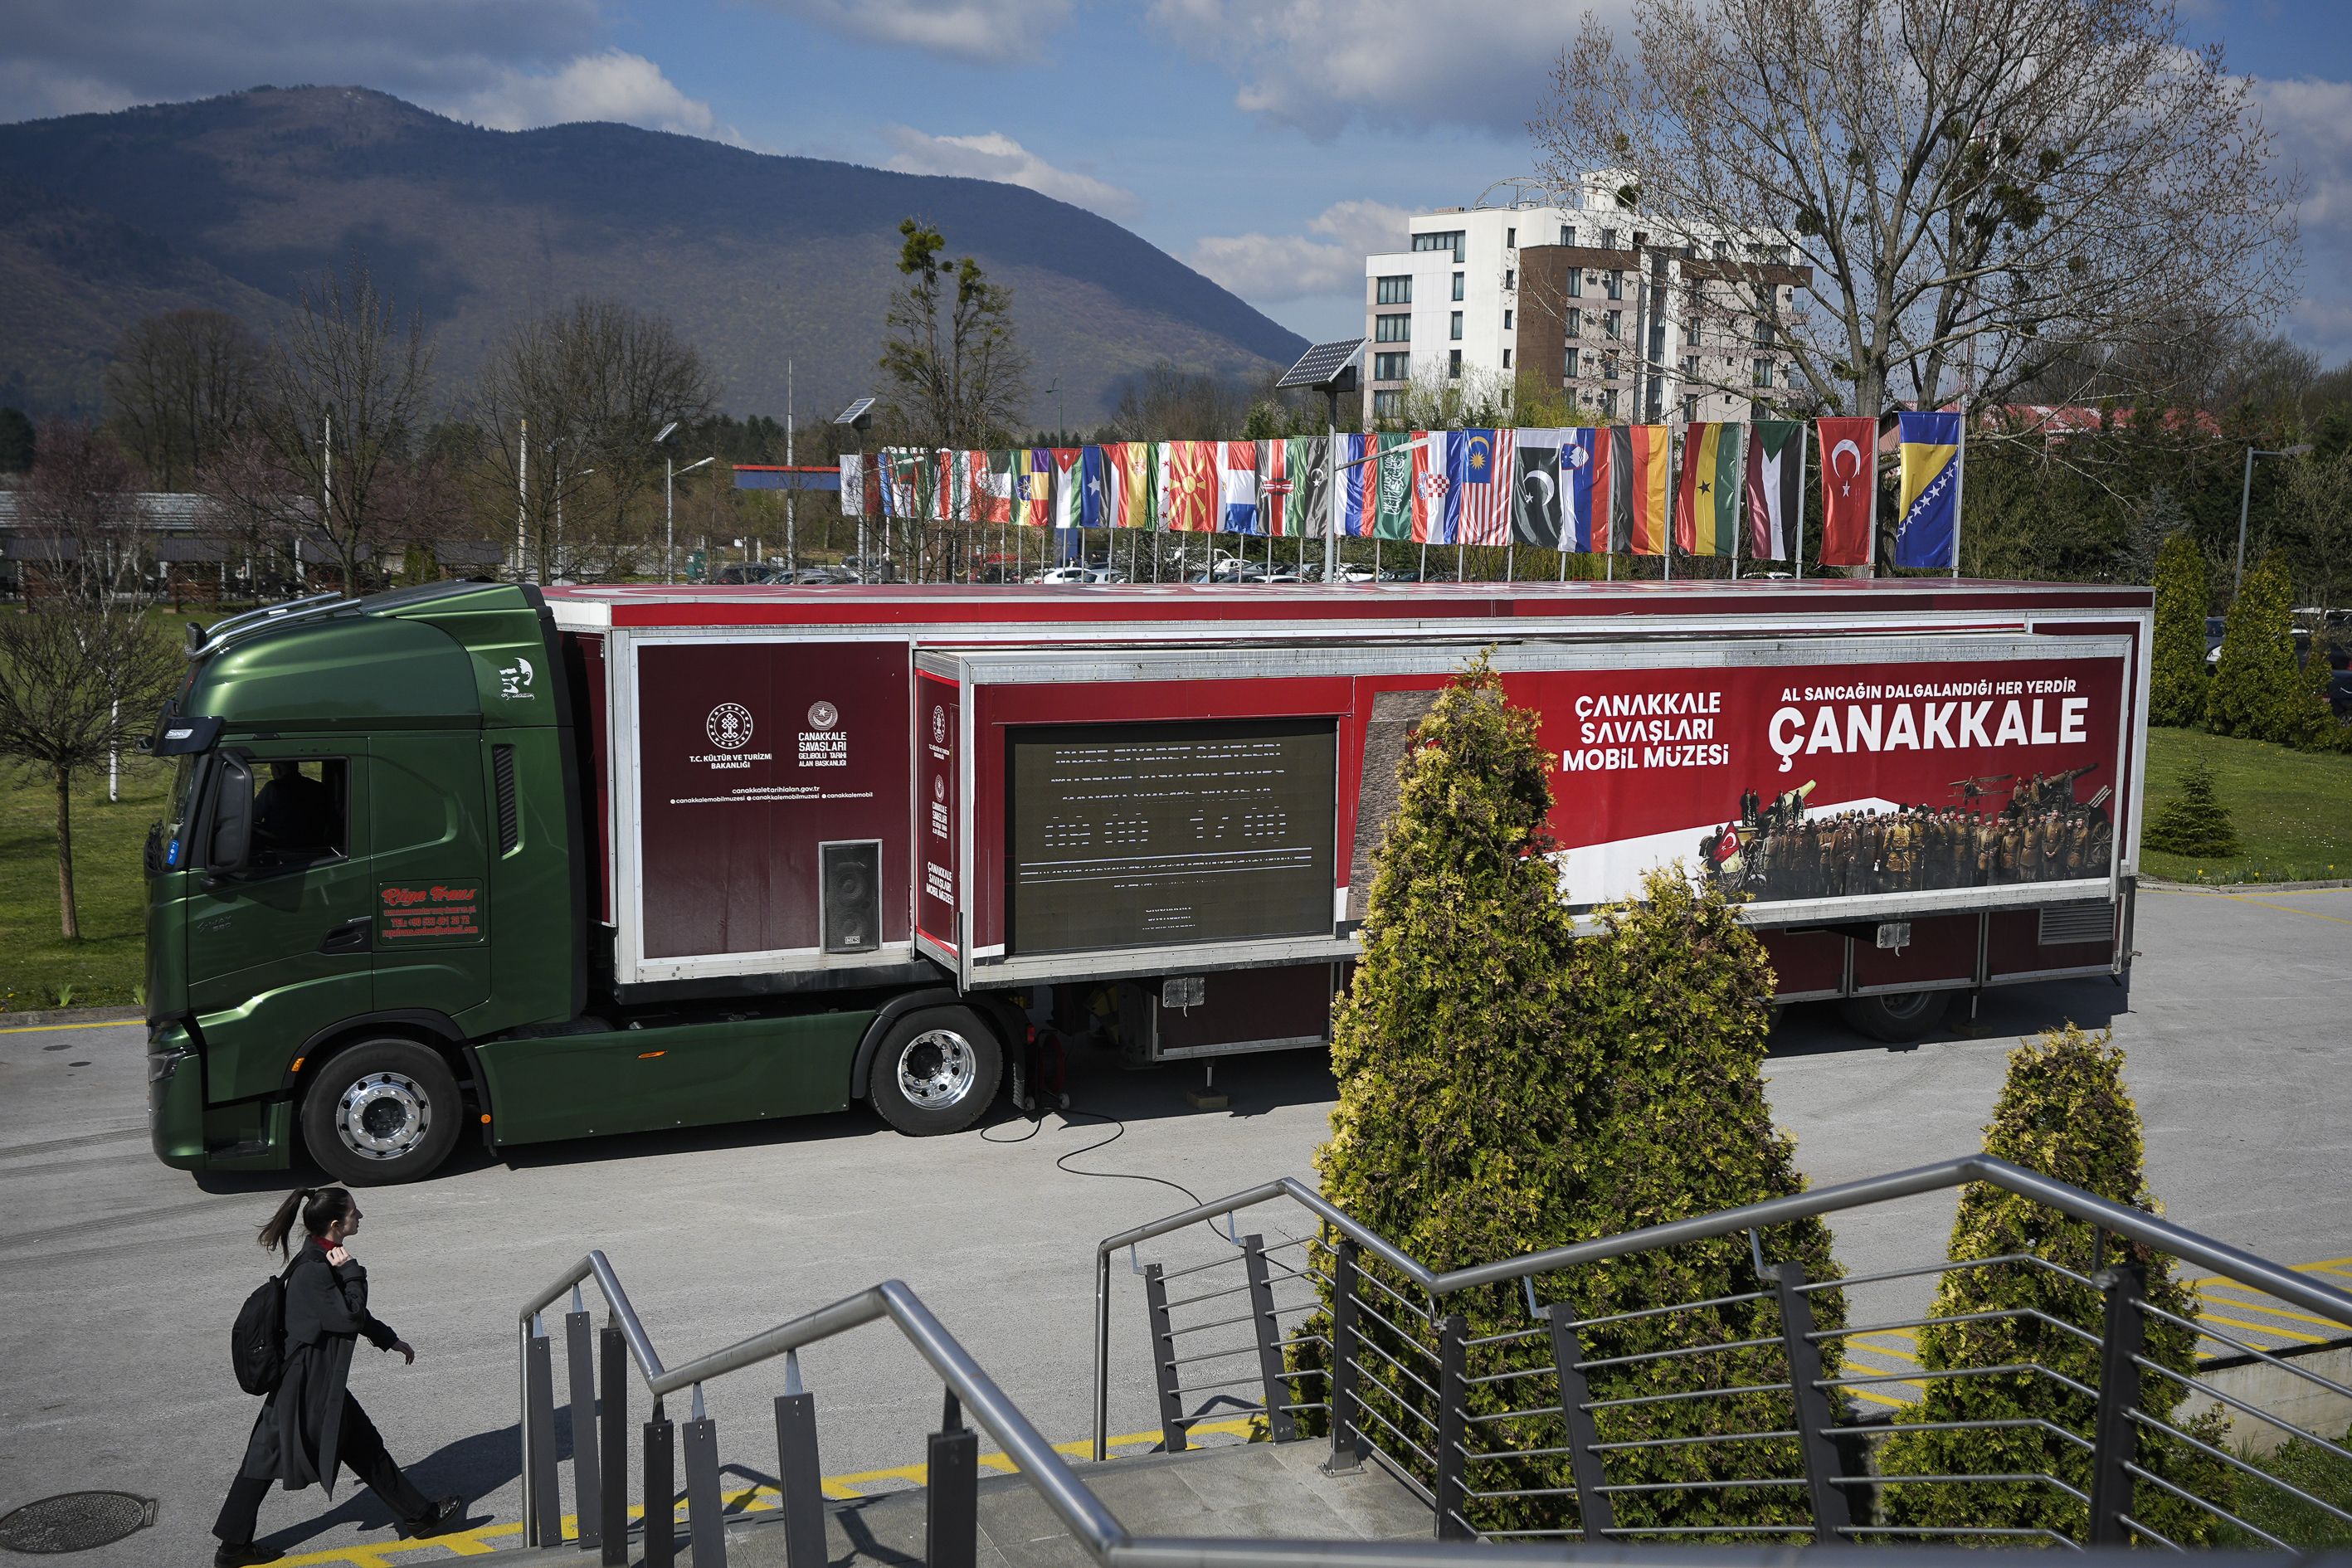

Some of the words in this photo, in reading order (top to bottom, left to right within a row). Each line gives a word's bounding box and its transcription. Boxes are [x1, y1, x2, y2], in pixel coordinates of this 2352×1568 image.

[1780, 687, 1801, 702] AL
[1804, 682, 1882, 701] SANCAĞIN
[1885, 679, 1993, 699] DALGALANDIĞI
[1995, 681, 2023, 695] HER
[2026, 676, 2077, 694] YERDİR
[1575, 691, 1721, 723] ÇANAKKALE
[1580, 718, 1714, 746] SAVAŞLARI
[1768, 697, 2089, 772] ÇANAKKALE
[703, 753, 732, 762] KÜLTÜR
[743, 752, 772, 761] TURİZM
[711, 761, 751, 769] BAKANLIĞI
[732, 786, 821, 794] canakkaletarihialan.gov.tr
